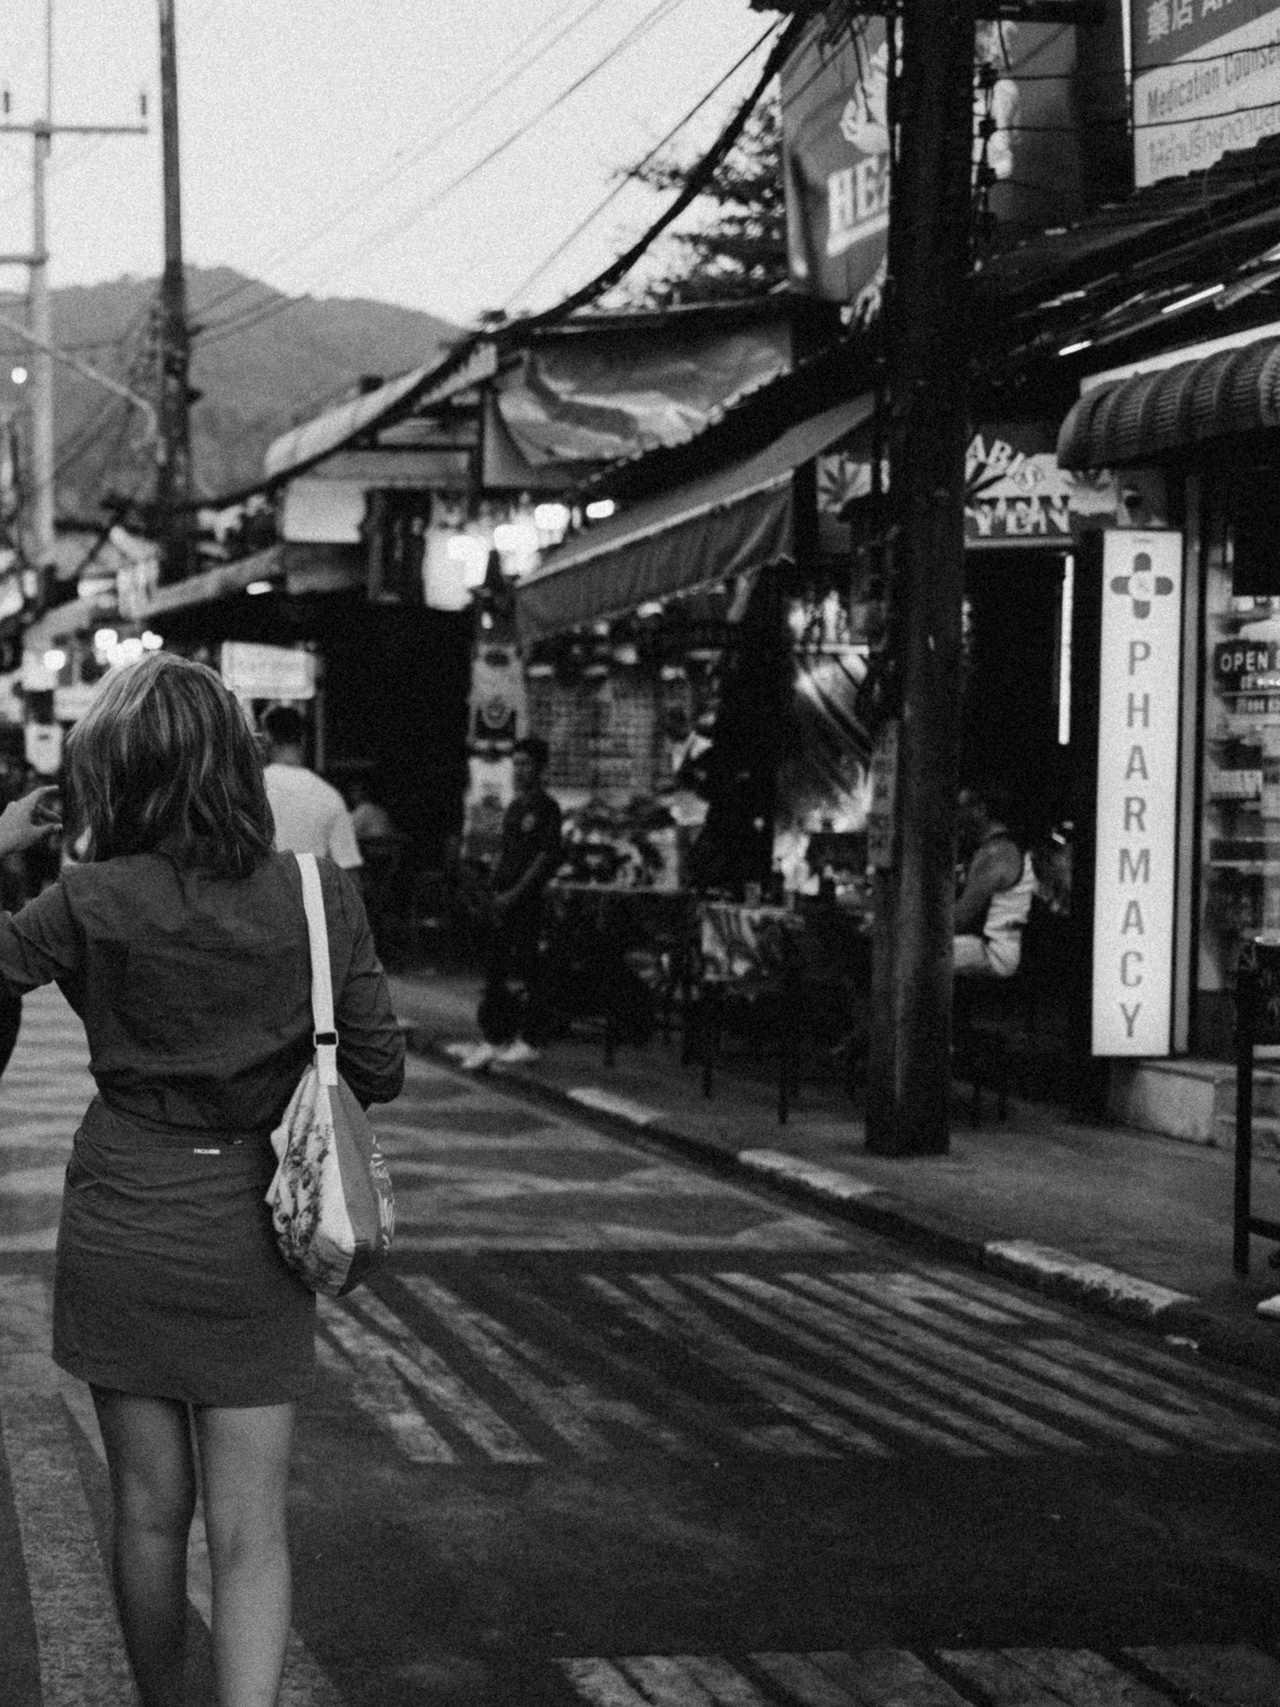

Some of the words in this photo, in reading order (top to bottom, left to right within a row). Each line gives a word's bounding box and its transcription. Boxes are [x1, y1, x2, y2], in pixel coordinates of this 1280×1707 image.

[1147, 67, 1220, 120] Medication
[965, 433, 1043, 491] ABIS
[1220, 650, 1269, 672] OPEN
[1118, 640, 1151, 1038] PHARMACY
